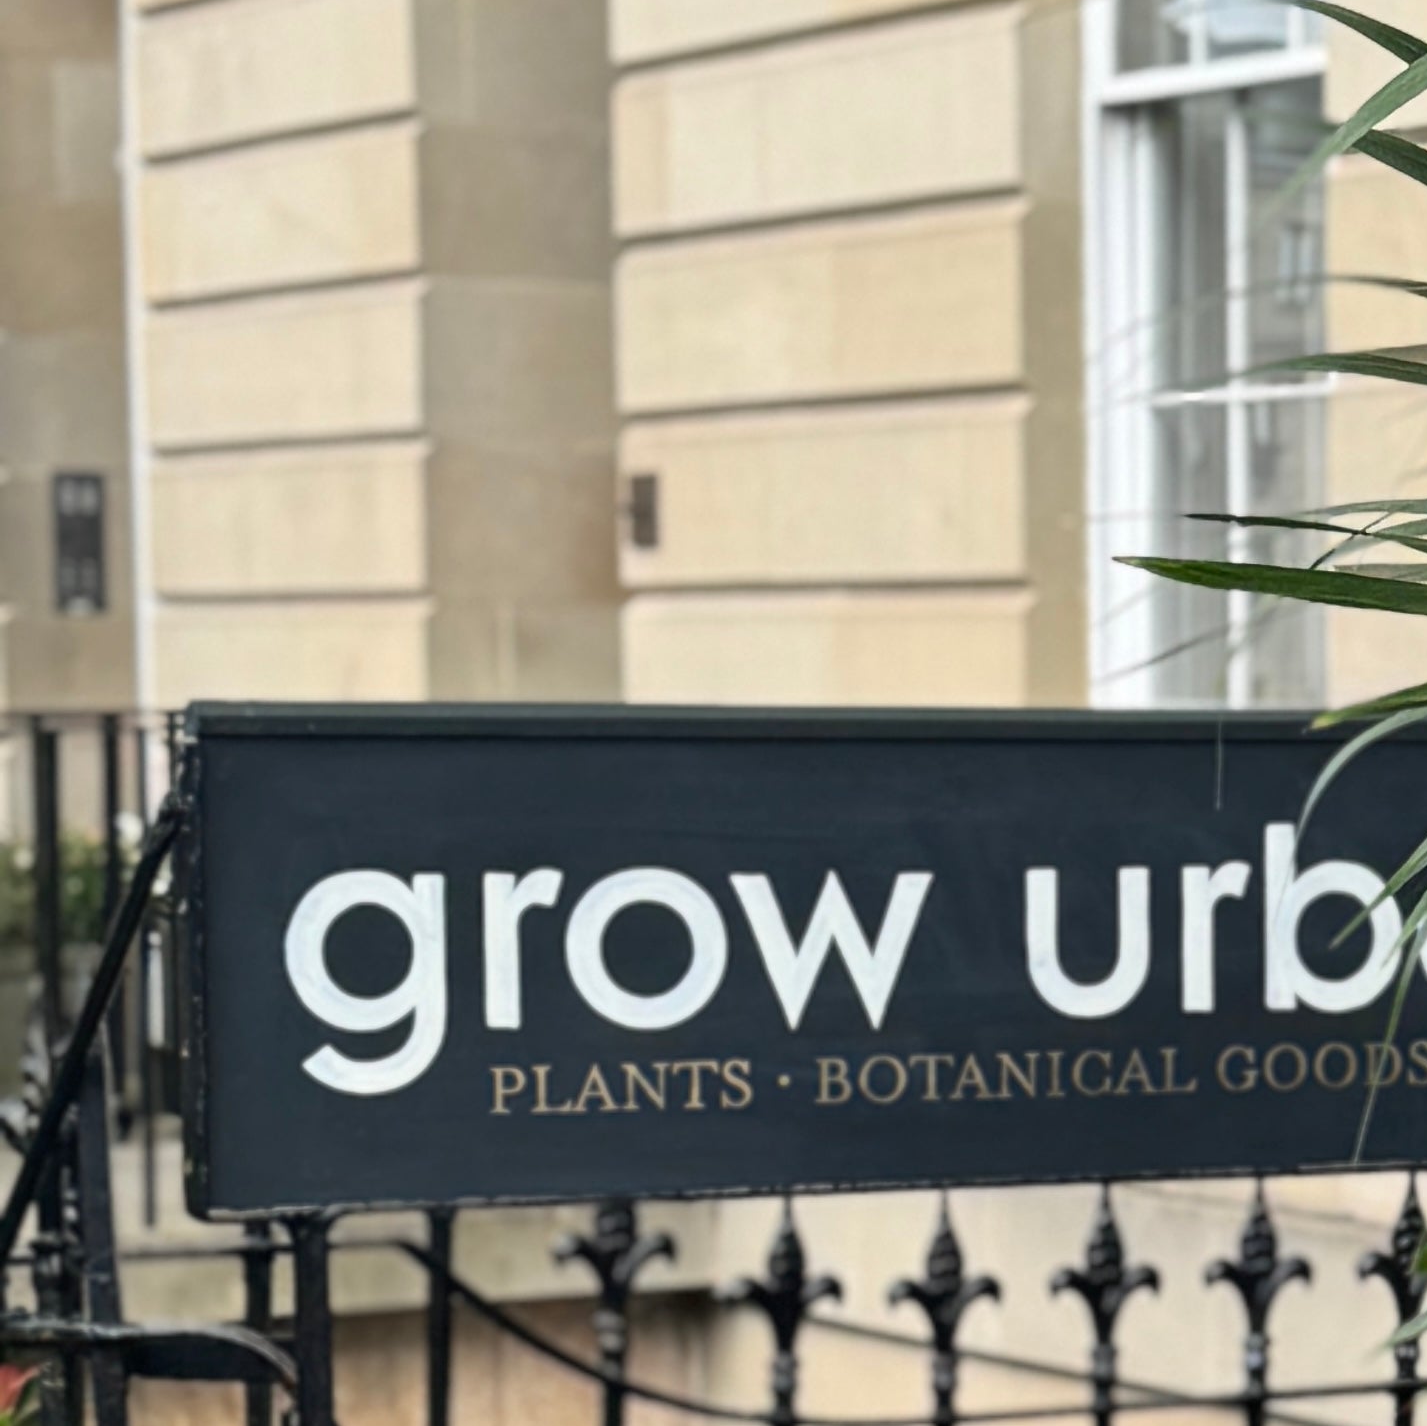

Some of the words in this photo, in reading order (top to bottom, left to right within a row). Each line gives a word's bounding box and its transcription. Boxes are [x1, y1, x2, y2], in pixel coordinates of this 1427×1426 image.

[284, 867, 934, 1096] grow
[490, 1060, 753, 1115] PLANTS
[815, 1047, 1197, 1104] BOTANICAL
